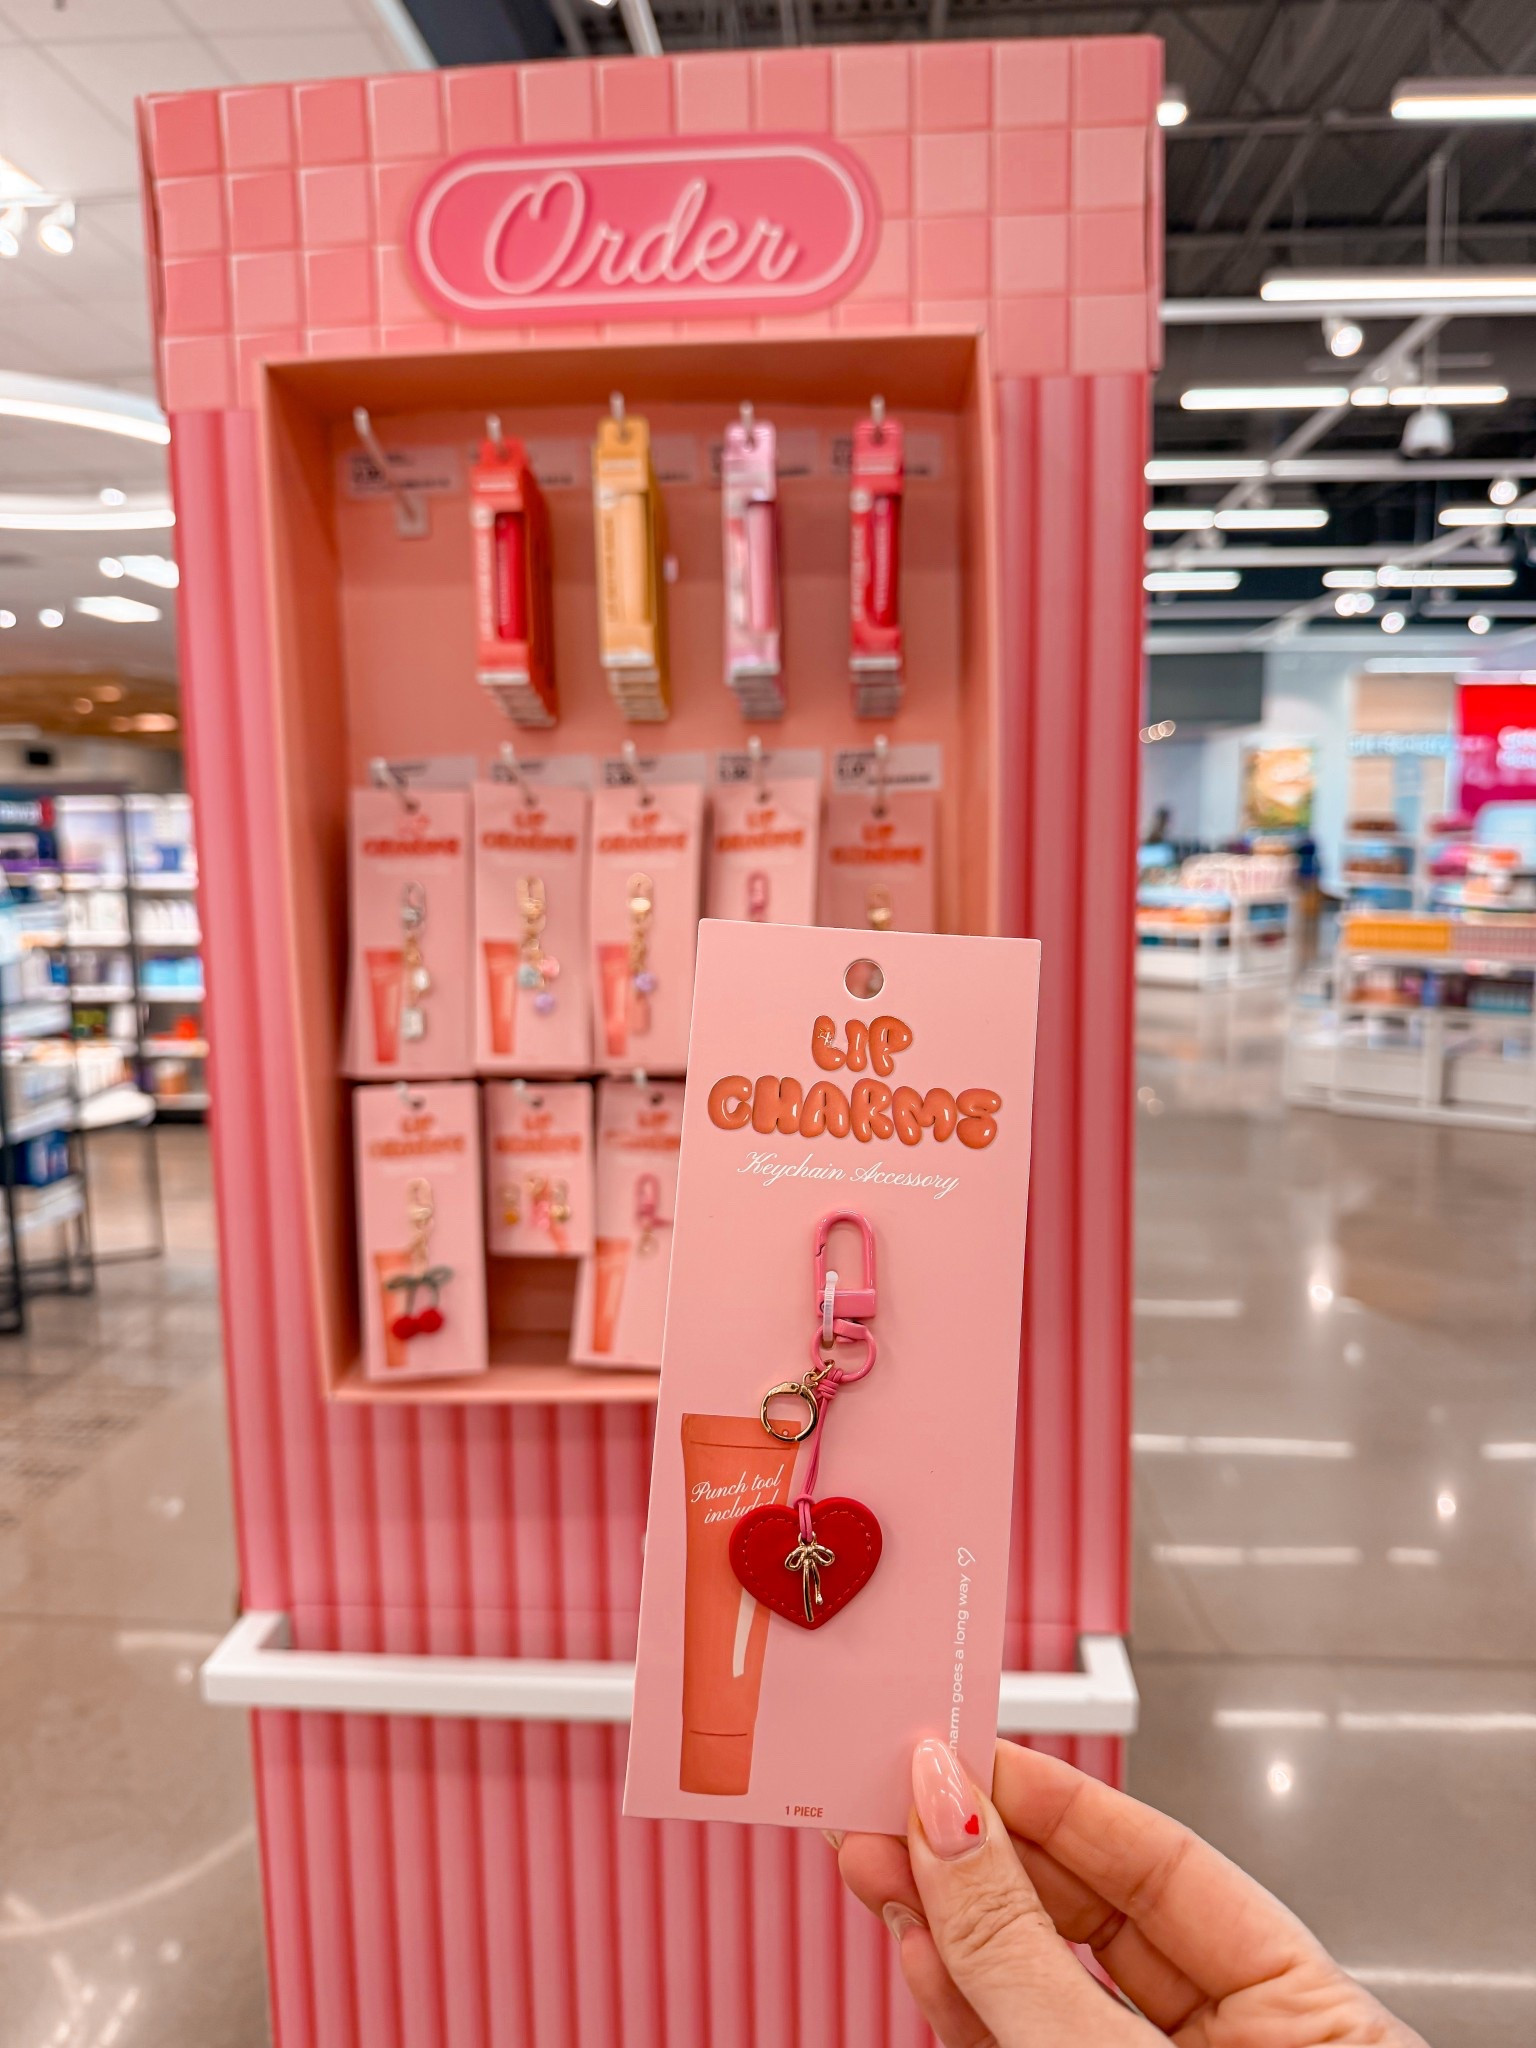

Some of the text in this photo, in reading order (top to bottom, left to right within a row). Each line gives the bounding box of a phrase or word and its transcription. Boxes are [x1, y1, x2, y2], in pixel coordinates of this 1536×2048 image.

[483, 169, 799, 294] Order
[811, 1014, 914, 1077] LIP
[707, 1074, 1003, 1149] CHARMS
[737, 1151, 961, 1200] Keychain Accessory
[691, 1463, 785, 1503] Punch tool
[959, 1573, 972, 1606] way
[954, 1609, 970, 1645] long
[955, 1649, 965, 1660] a
[953, 1663, 964, 1703] goes
[785, 1805, 824, 1818] 1 PIECE
